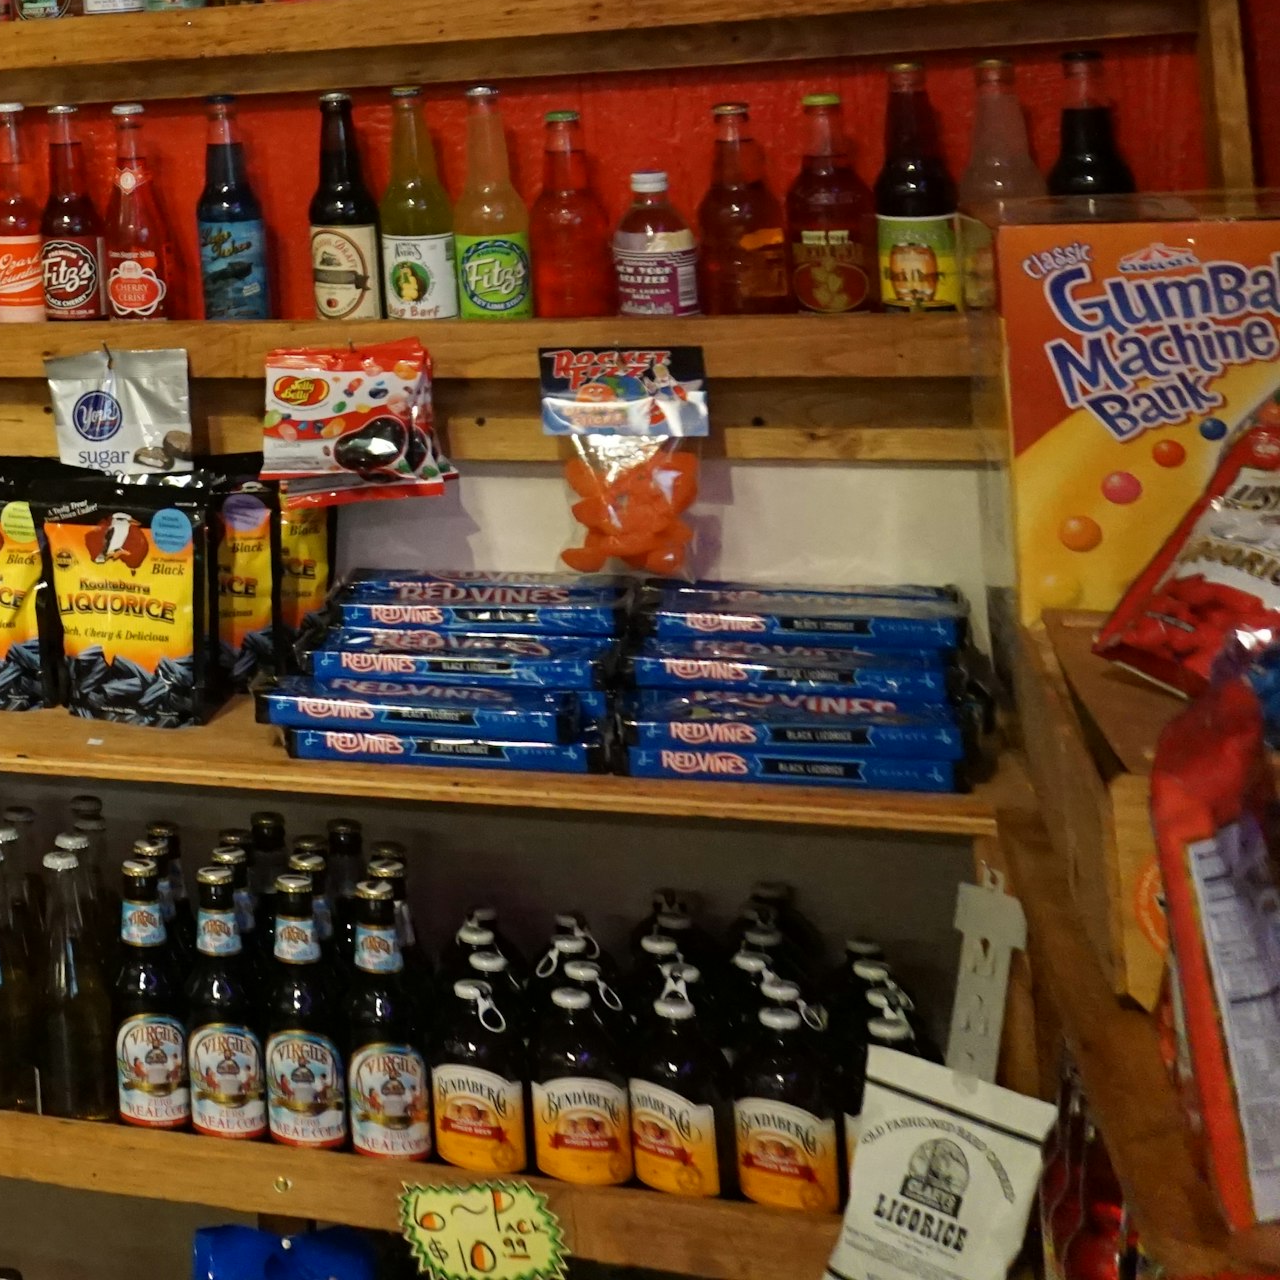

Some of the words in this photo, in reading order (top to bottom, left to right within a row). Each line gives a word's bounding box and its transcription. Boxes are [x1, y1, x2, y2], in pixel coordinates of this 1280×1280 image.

[467, 257, 528, 290] Fitz's
[551, 349, 671, 379] ROCKET
[1050, 321, 1276, 404] Machine
[1087, 373, 1219, 438] Bank
[77, 447, 131, 470] sugar
[5, 553, 37, 566] Black
[79, 578, 151, 595] Kookaburra
[59, 595, 177, 623] LIQUORICE
[778, 762, 807, 777] BLACK
[811, 763, 848, 778] LICORICE
[872, 1194, 969, 1253] LICORICE
